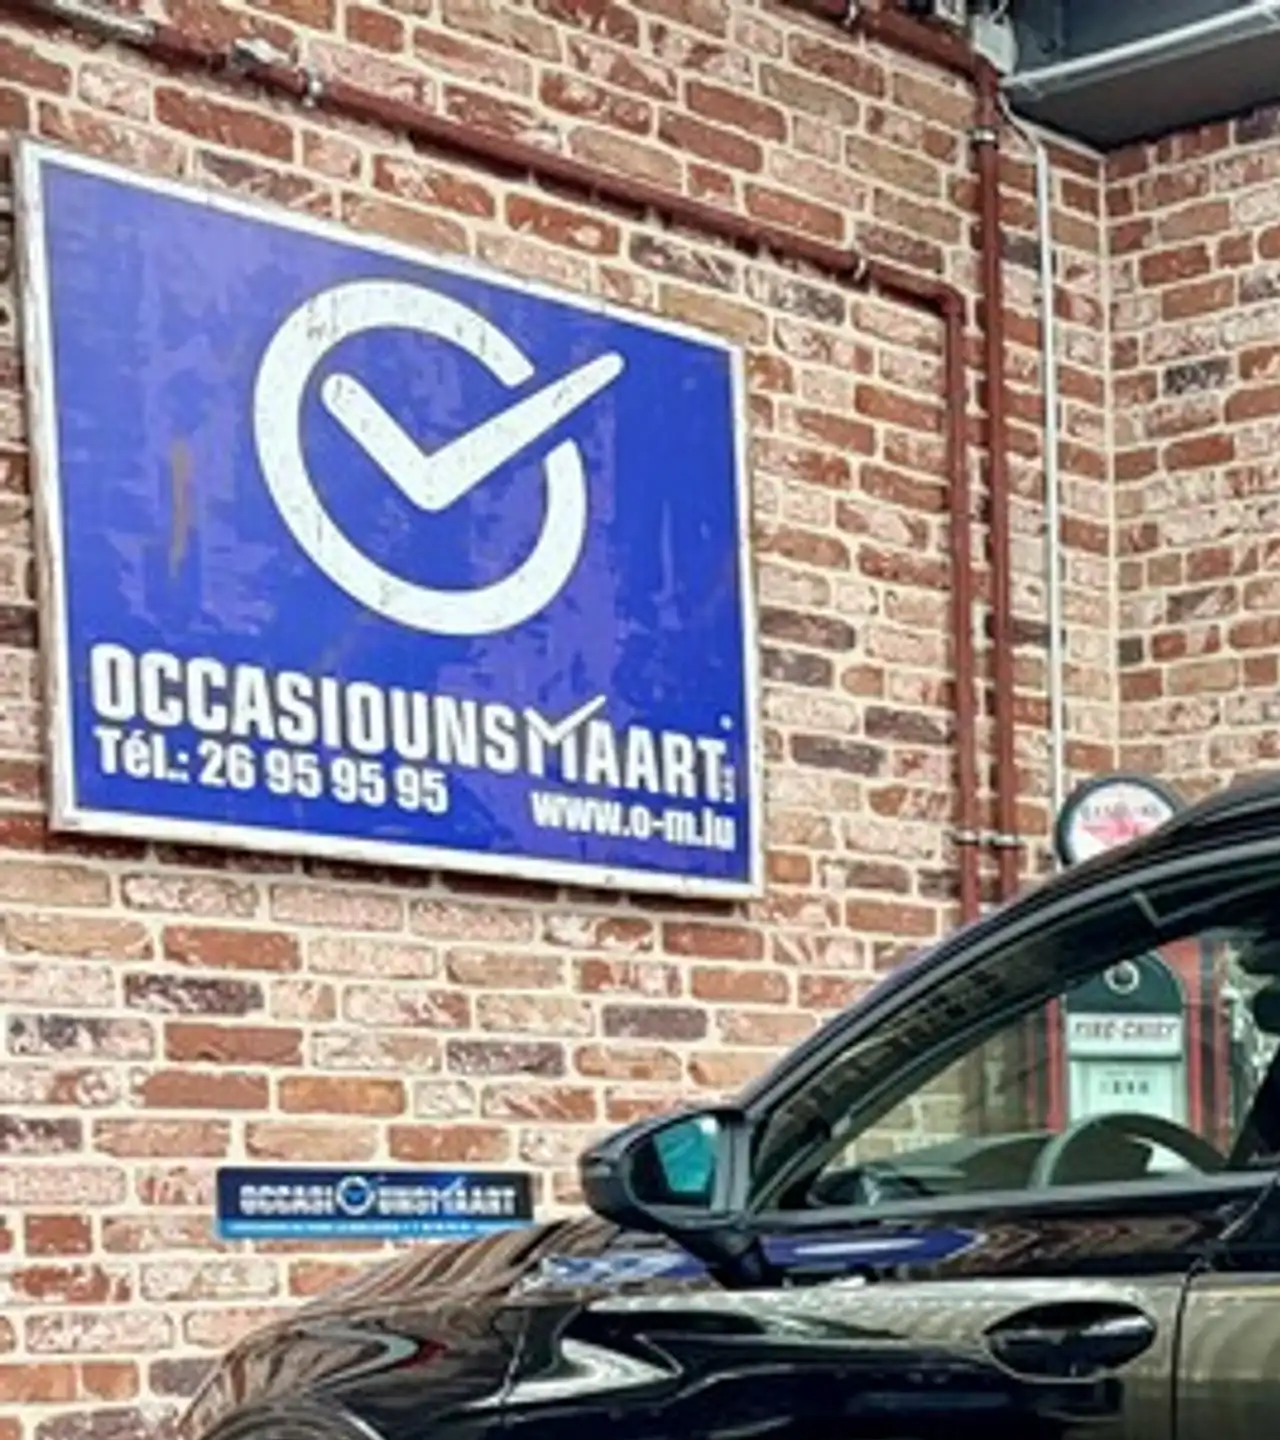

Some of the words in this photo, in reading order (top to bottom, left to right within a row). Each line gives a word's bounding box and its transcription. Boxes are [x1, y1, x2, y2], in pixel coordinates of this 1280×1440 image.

[91, 643, 727, 803] OCCASIOUNSMAART
[94, 725, 189, 783] Tél.:
[197, 739, 256, 790] 26
[265, 749, 322, 799] 95
[331, 756, 387, 807] 95
[394, 763, 448, 814] 95
[530, 790, 736, 851] www.o-m.lu
